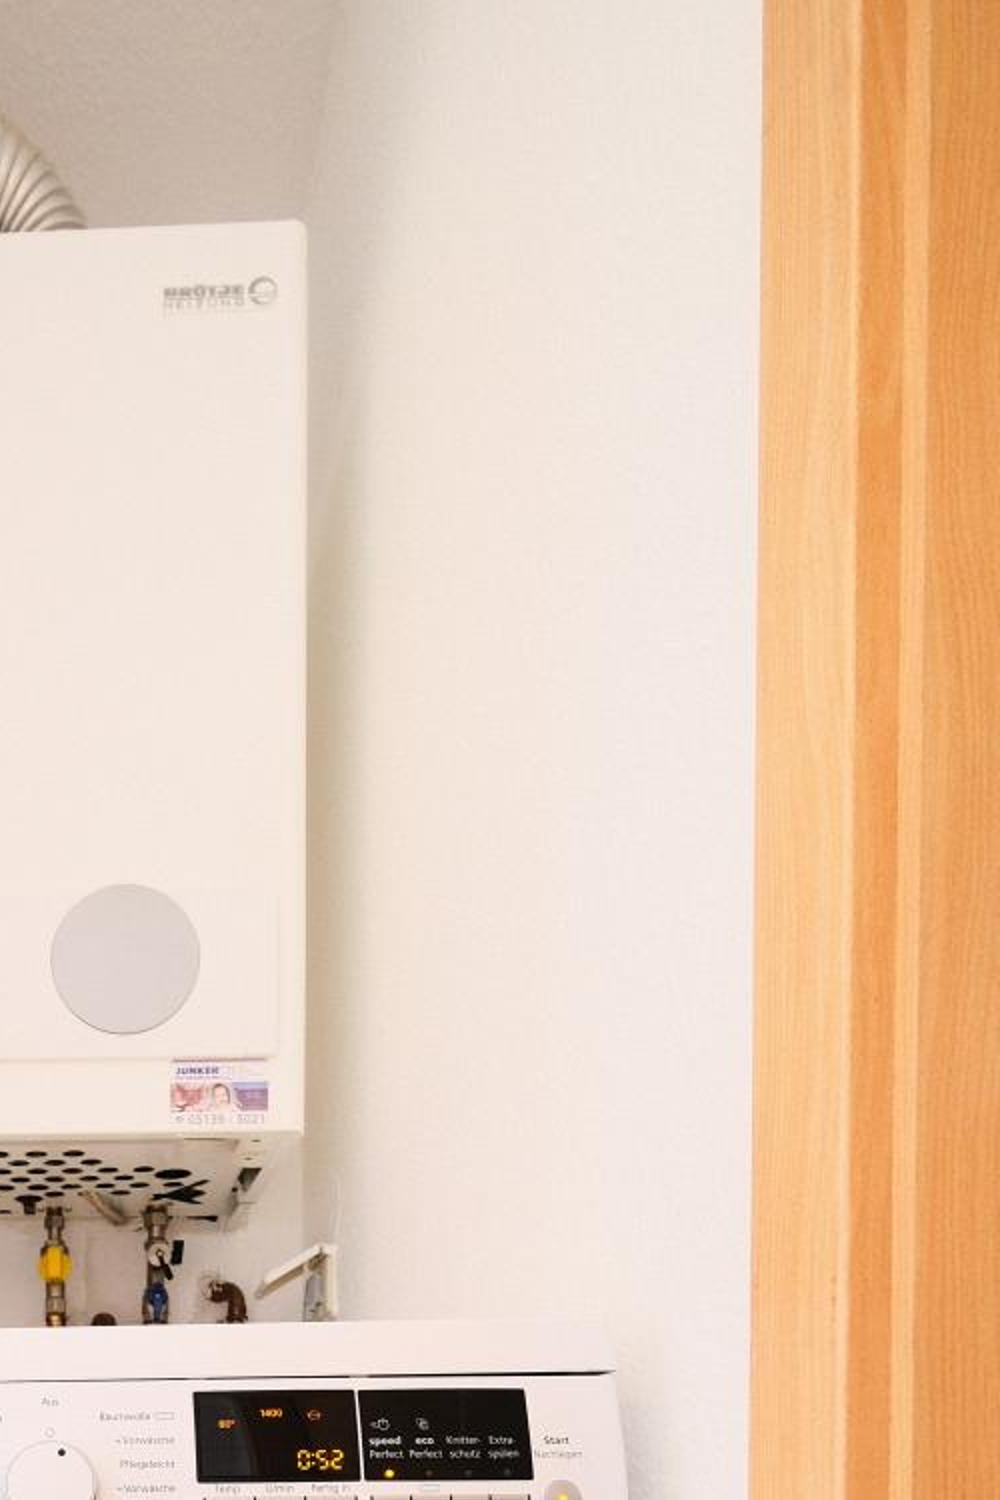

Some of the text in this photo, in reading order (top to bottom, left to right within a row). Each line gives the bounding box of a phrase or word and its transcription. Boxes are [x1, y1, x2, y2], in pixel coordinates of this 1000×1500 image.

[368, 1435, 402, 1447] speed
[414, 1437, 435, 1445] eco
[543, 1435, 569, 1445] Start
[369, 1448, 405, 1459] Perfect
[408, 1447, 444, 1459] Perfect
[449, 1448, 481, 1459] schutz
[296, 1449, 345, 1471] 0:52
